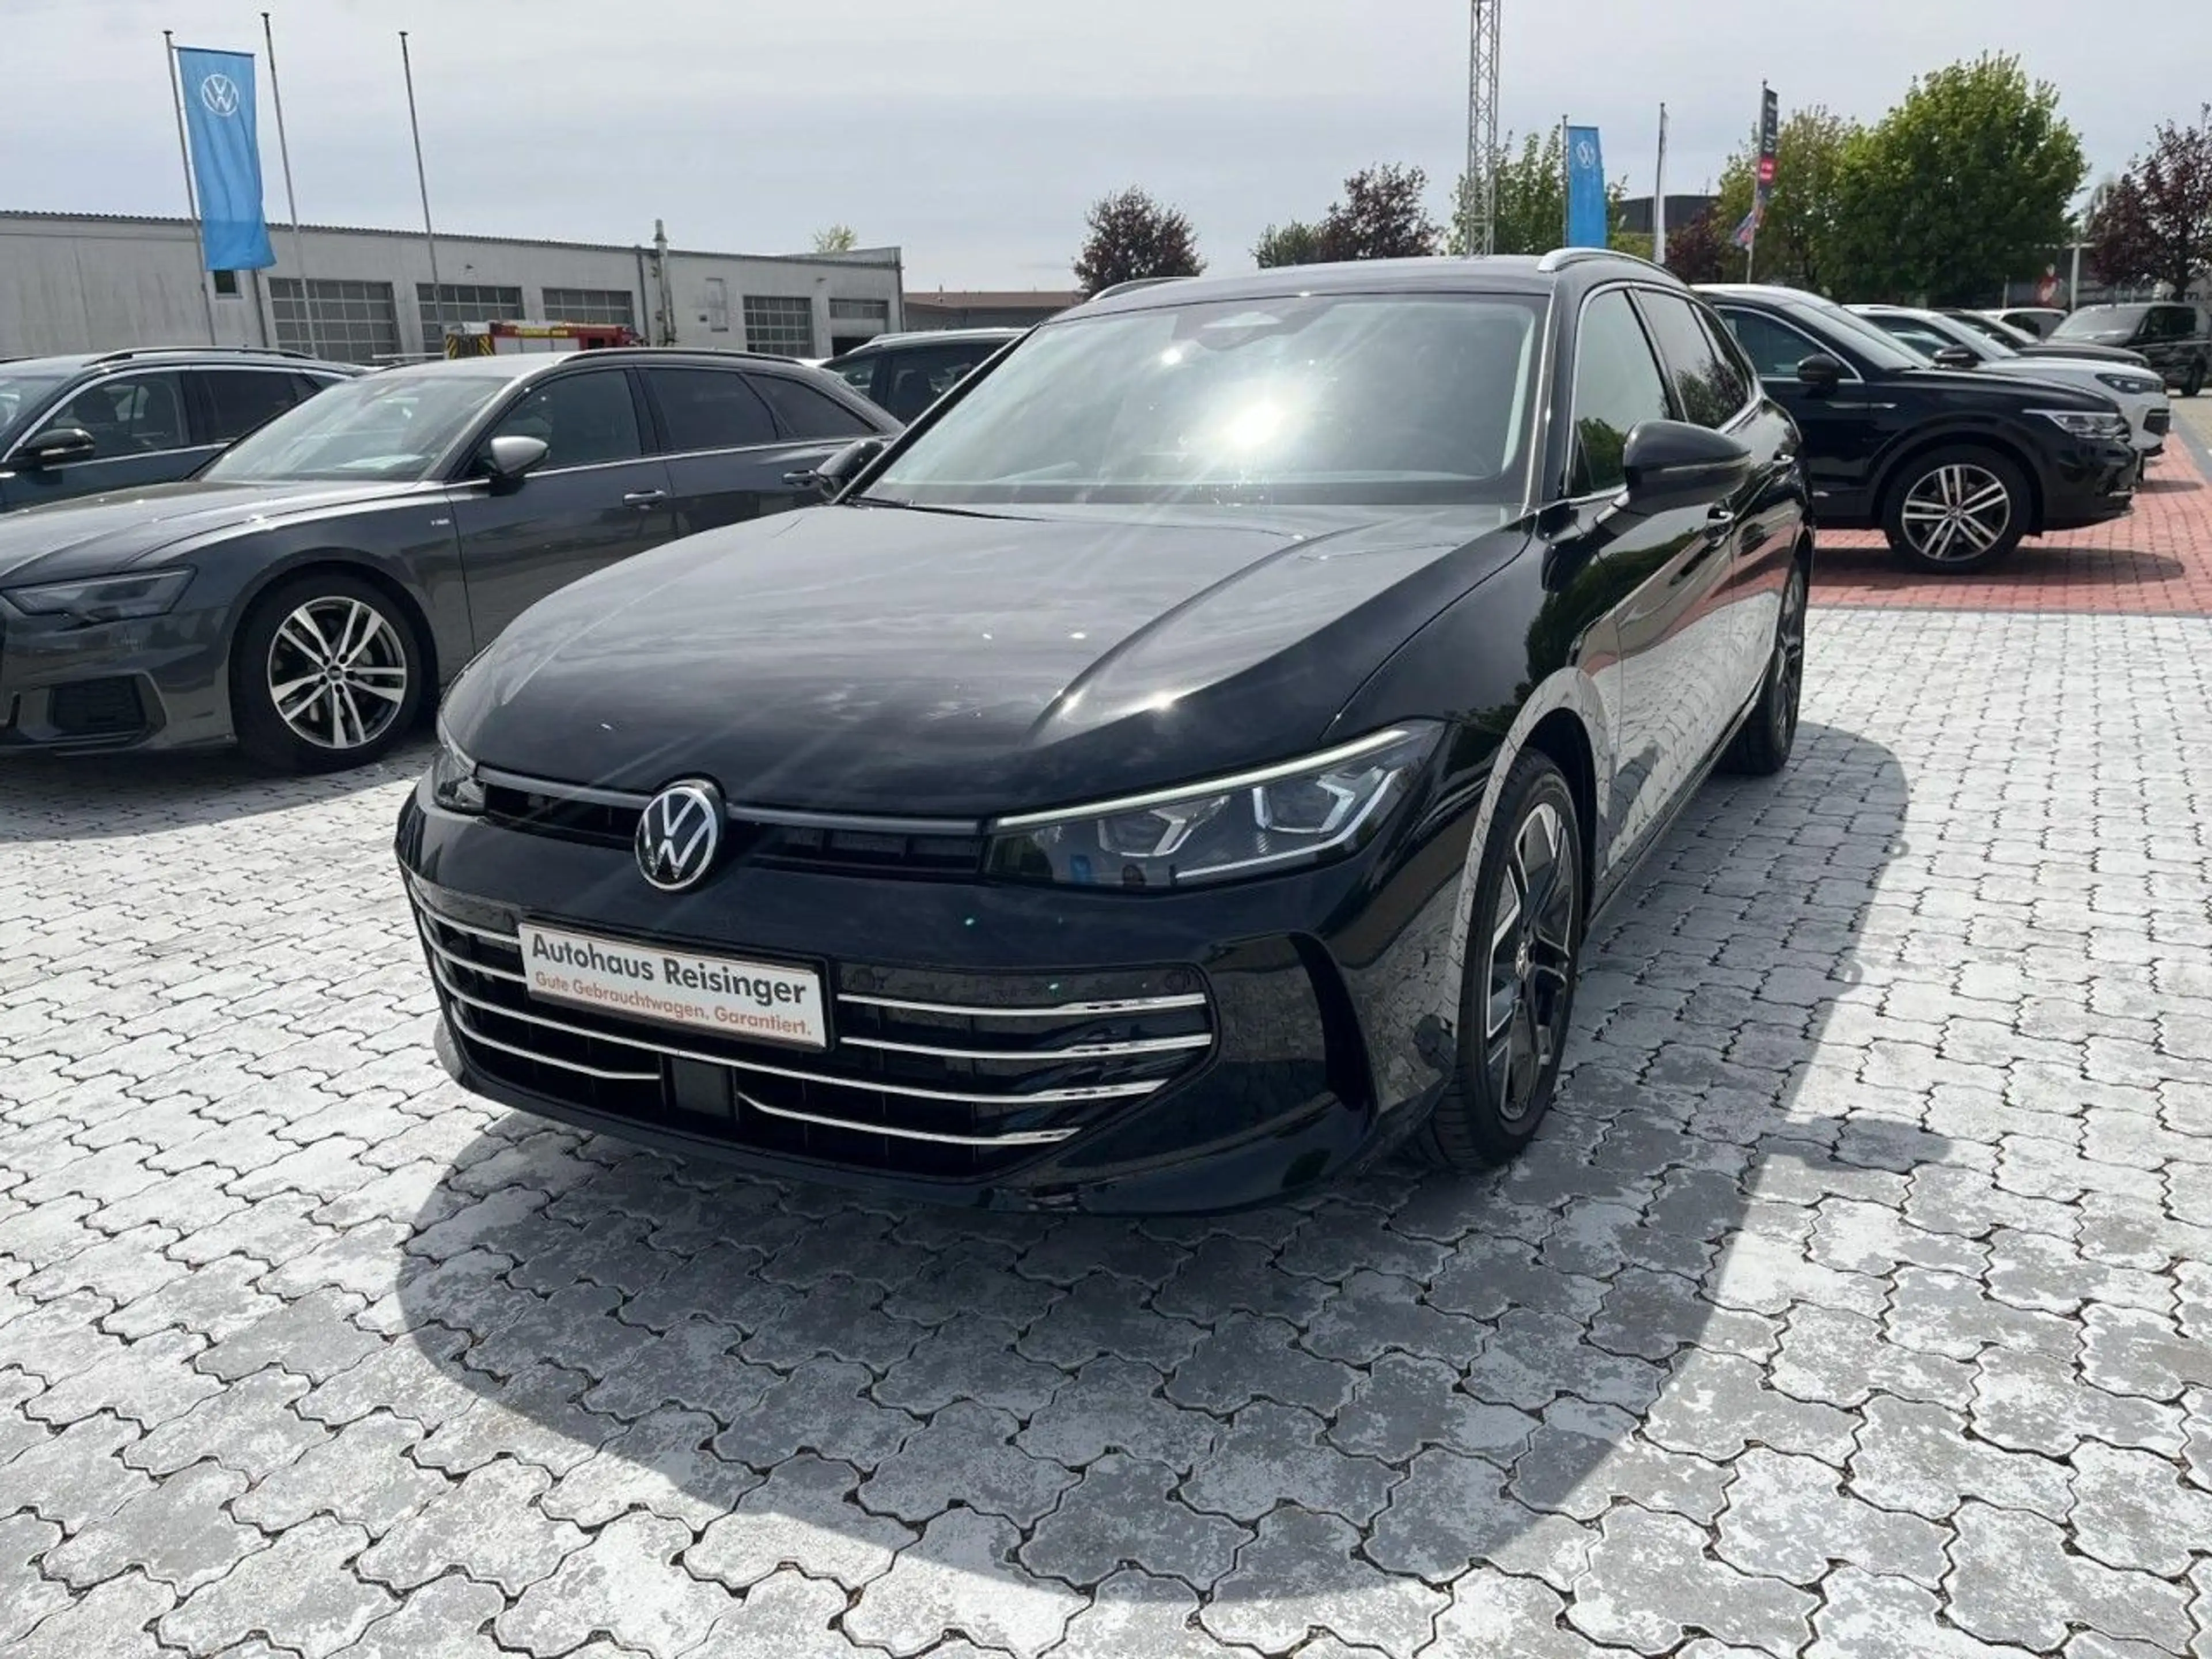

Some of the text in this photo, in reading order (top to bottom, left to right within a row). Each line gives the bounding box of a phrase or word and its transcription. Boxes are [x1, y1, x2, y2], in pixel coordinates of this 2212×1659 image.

[532, 933, 807, 1007] Autohaus Reisinger
[536, 971, 812, 1036] Gute Gebrauchtwagen. Garantiert.
